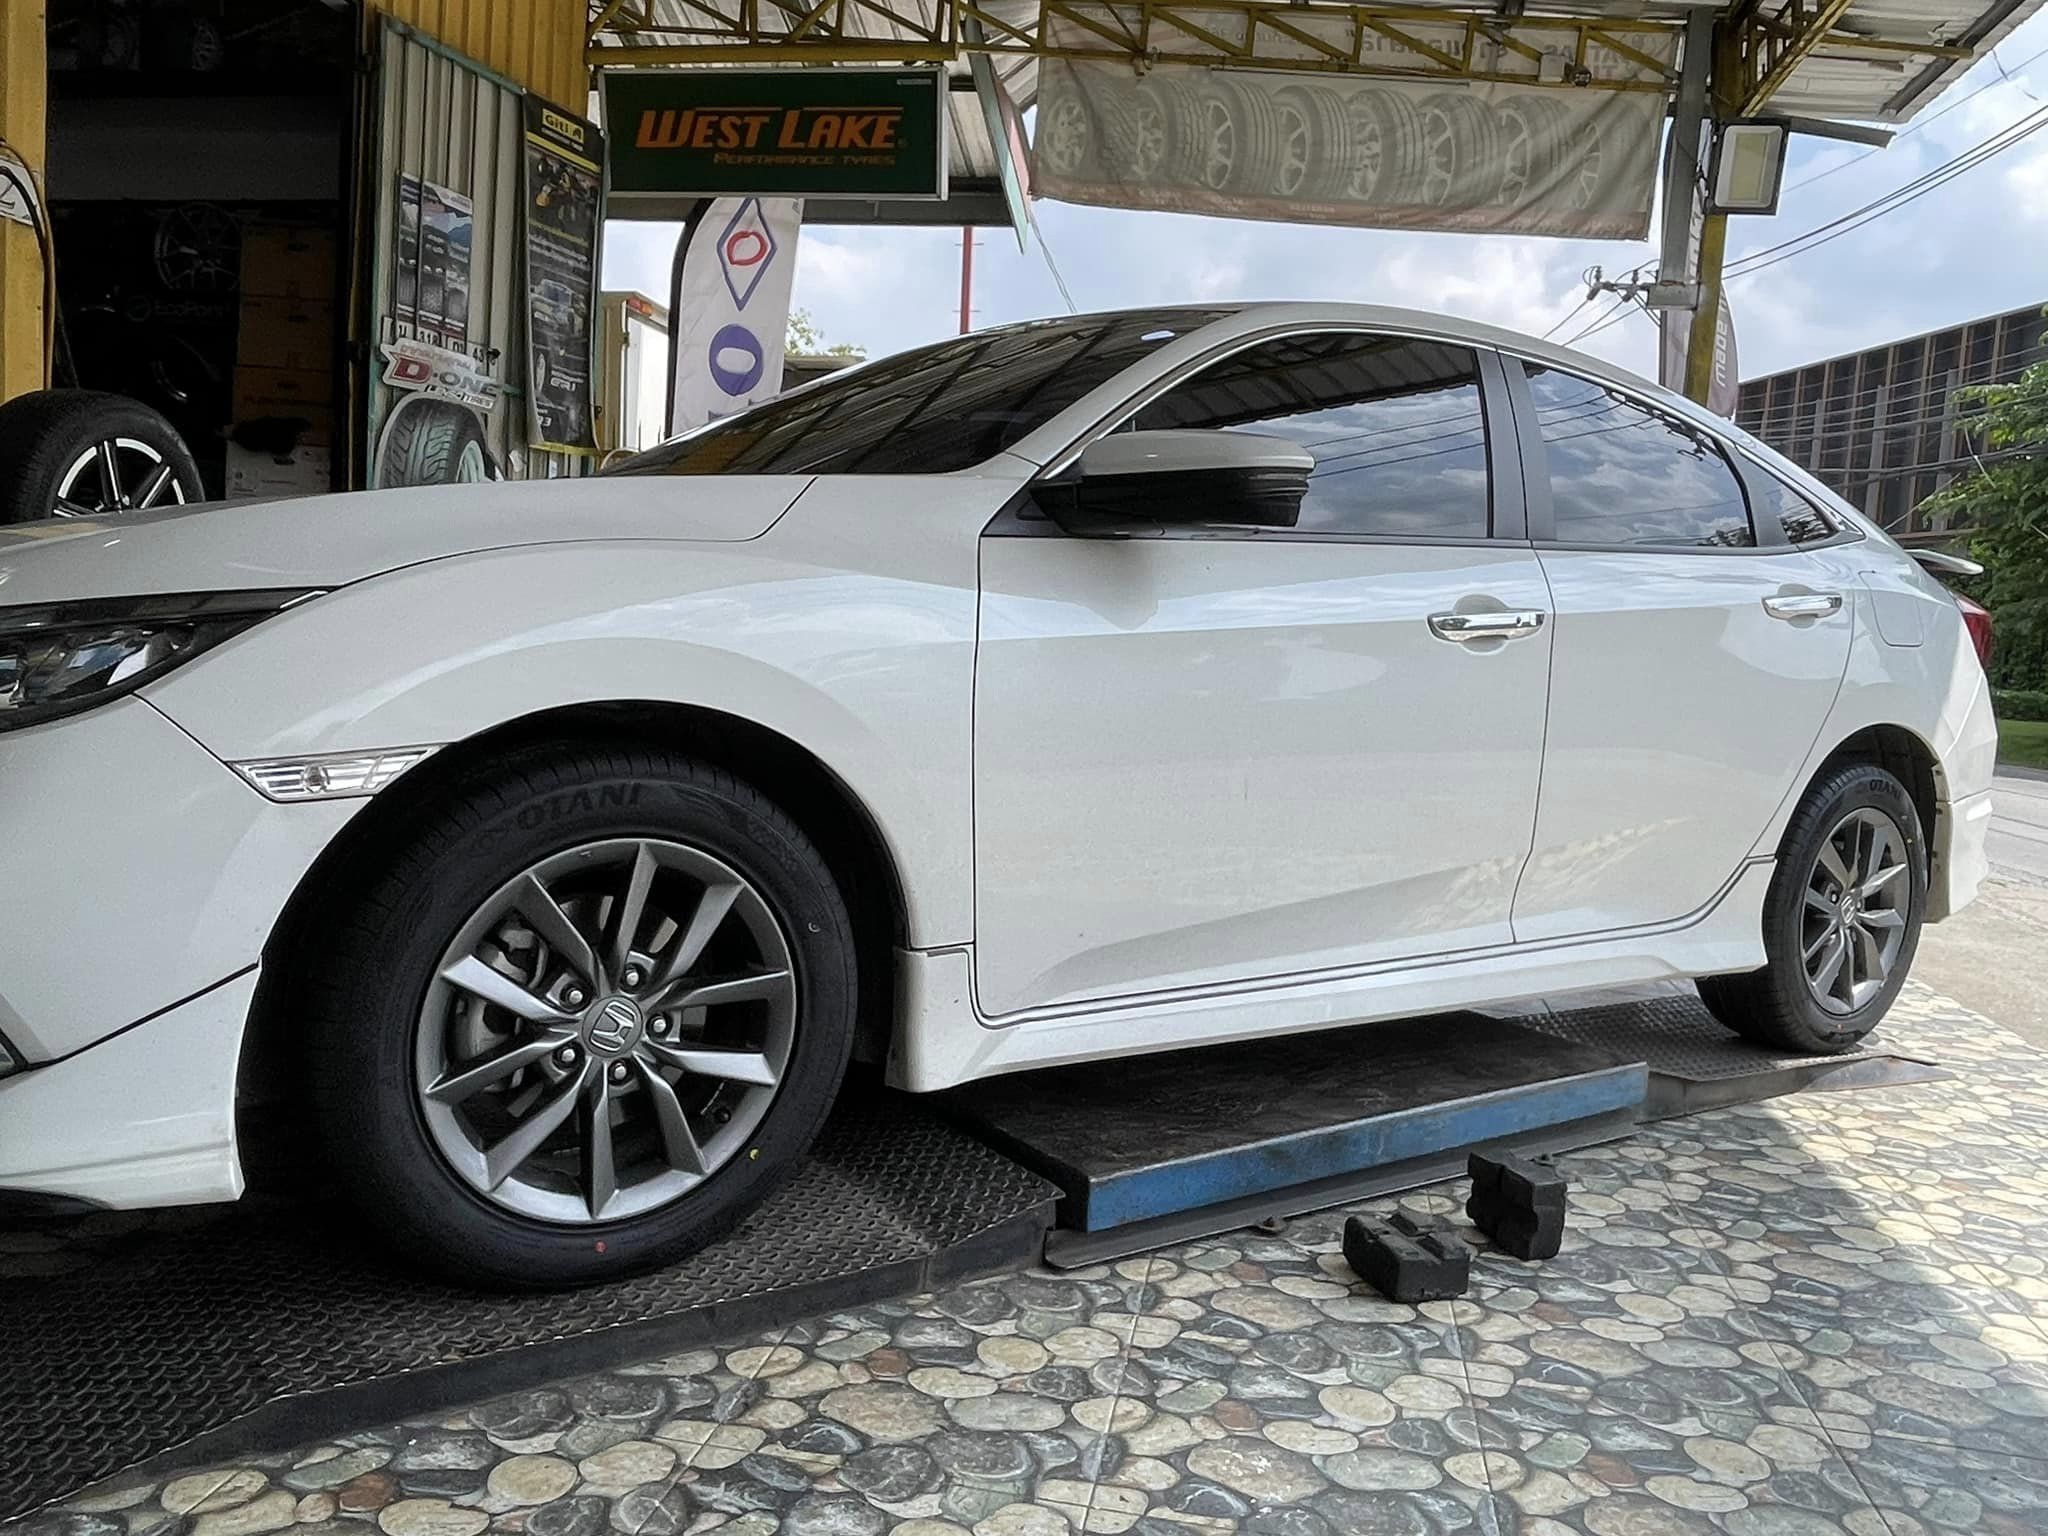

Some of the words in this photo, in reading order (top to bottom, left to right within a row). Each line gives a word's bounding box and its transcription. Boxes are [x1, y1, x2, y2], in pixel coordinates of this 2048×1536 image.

[635, 109, 770, 149] WEST
[777, 109, 902, 149] LAKE
[517, 782, 641, 830] OTANI
